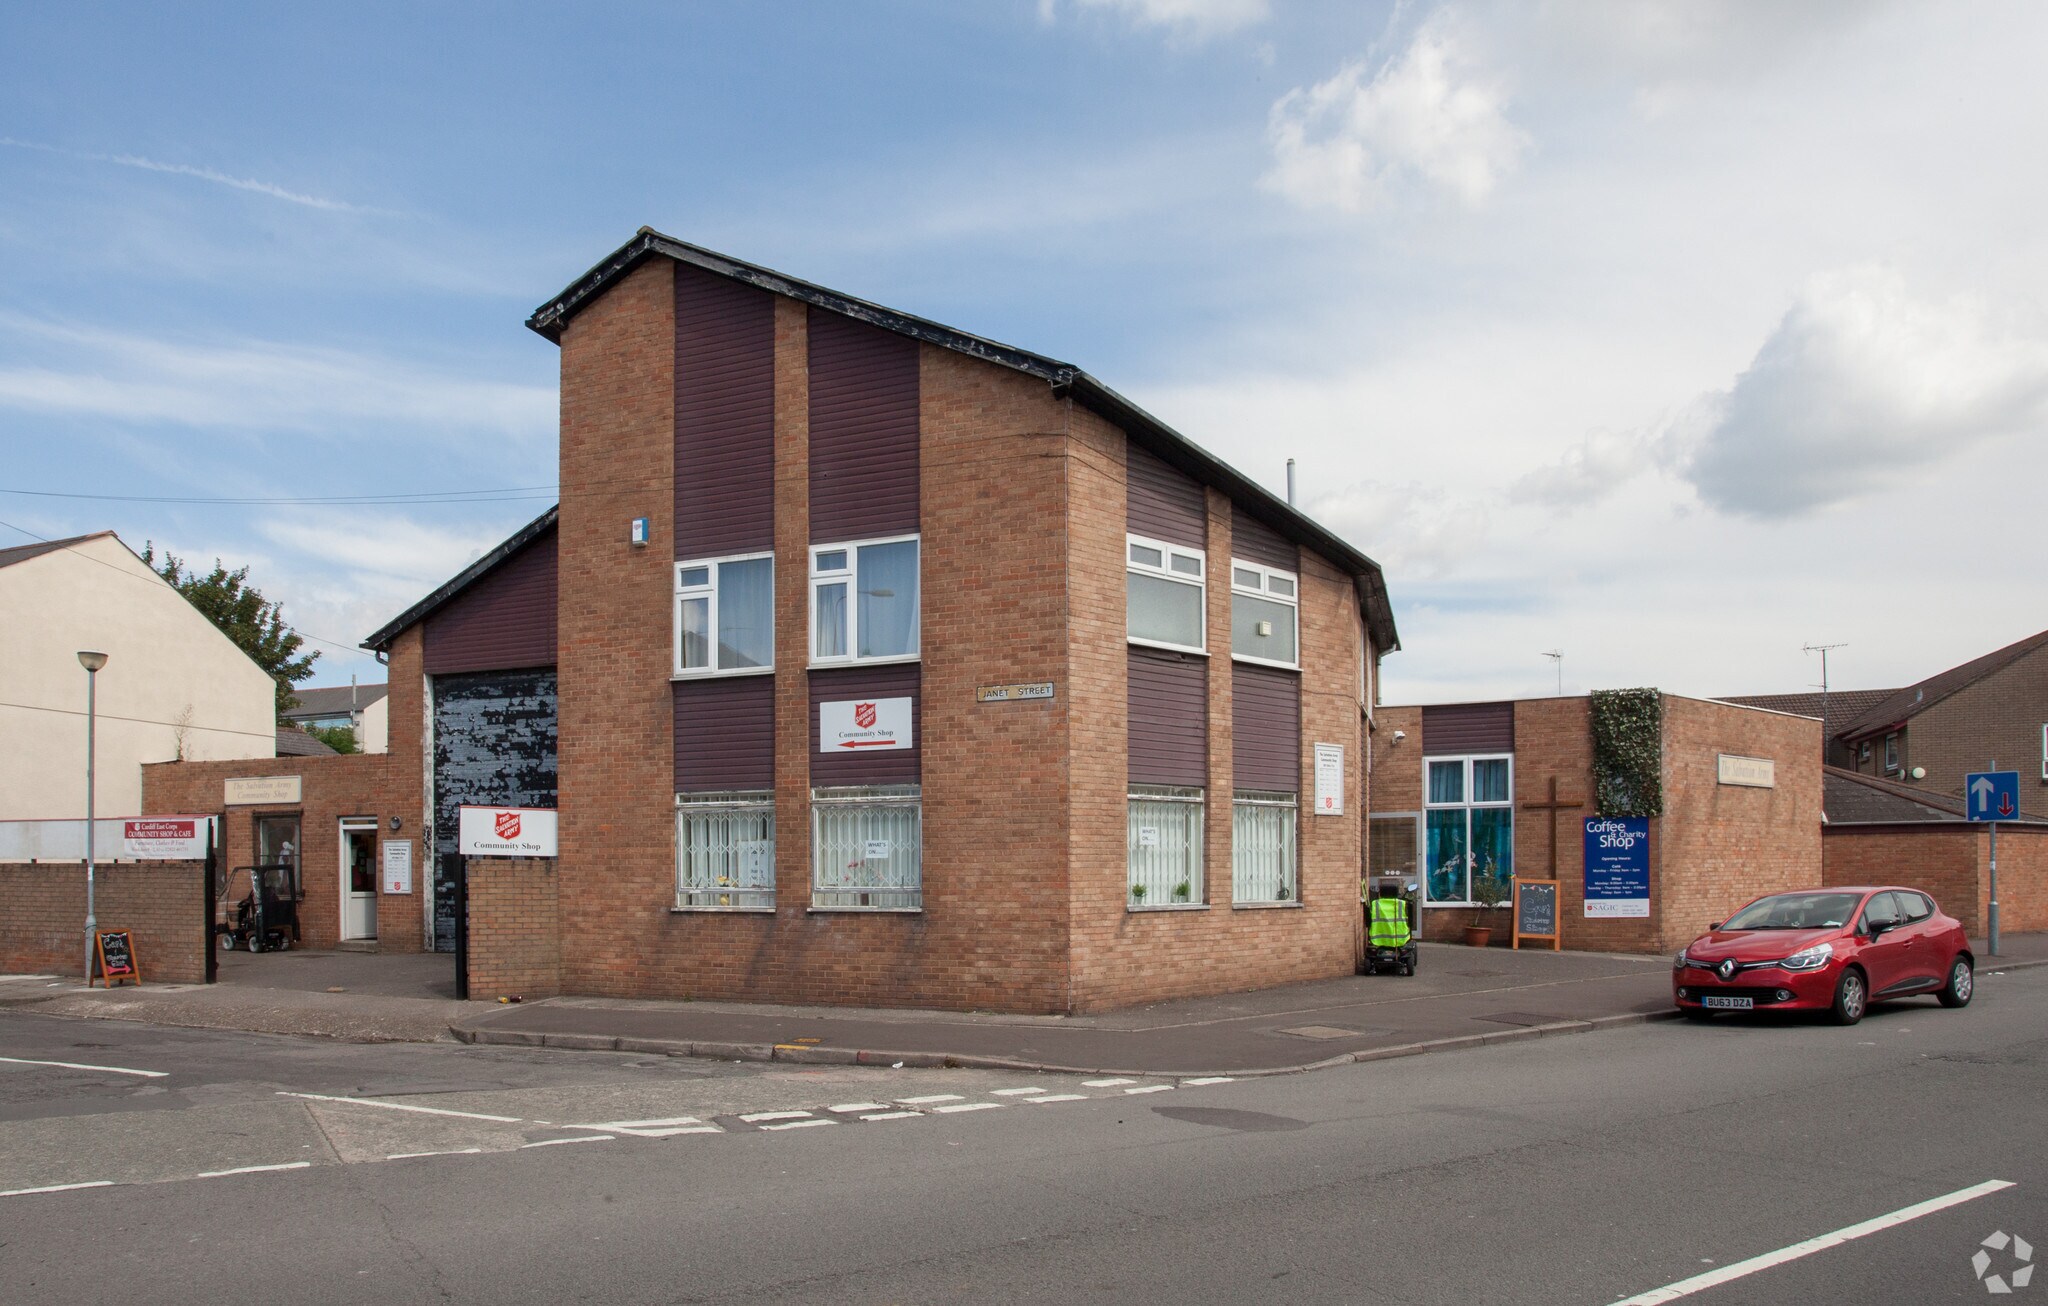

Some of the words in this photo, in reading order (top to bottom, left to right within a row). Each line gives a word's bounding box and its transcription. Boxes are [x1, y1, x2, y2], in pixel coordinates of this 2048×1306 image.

[983, 689, 1009, 697] JANET
[1018, 686, 1050, 696] STREET
[499, 814, 511, 824] THE
[495, 816, 519, 834] SALVATION
[1586, 821, 1626, 833] Coffee
[503, 824, 519, 838] ARMY
[1619, 831, 1646, 839] Charity
[473, 841, 519, 850] Community
[521, 842, 541, 851] Shop
[1600, 835, 1634, 850] Shop
[1707, 997, 1731, 1007] BU63
[1732, 998, 1752, 1007] DZA
